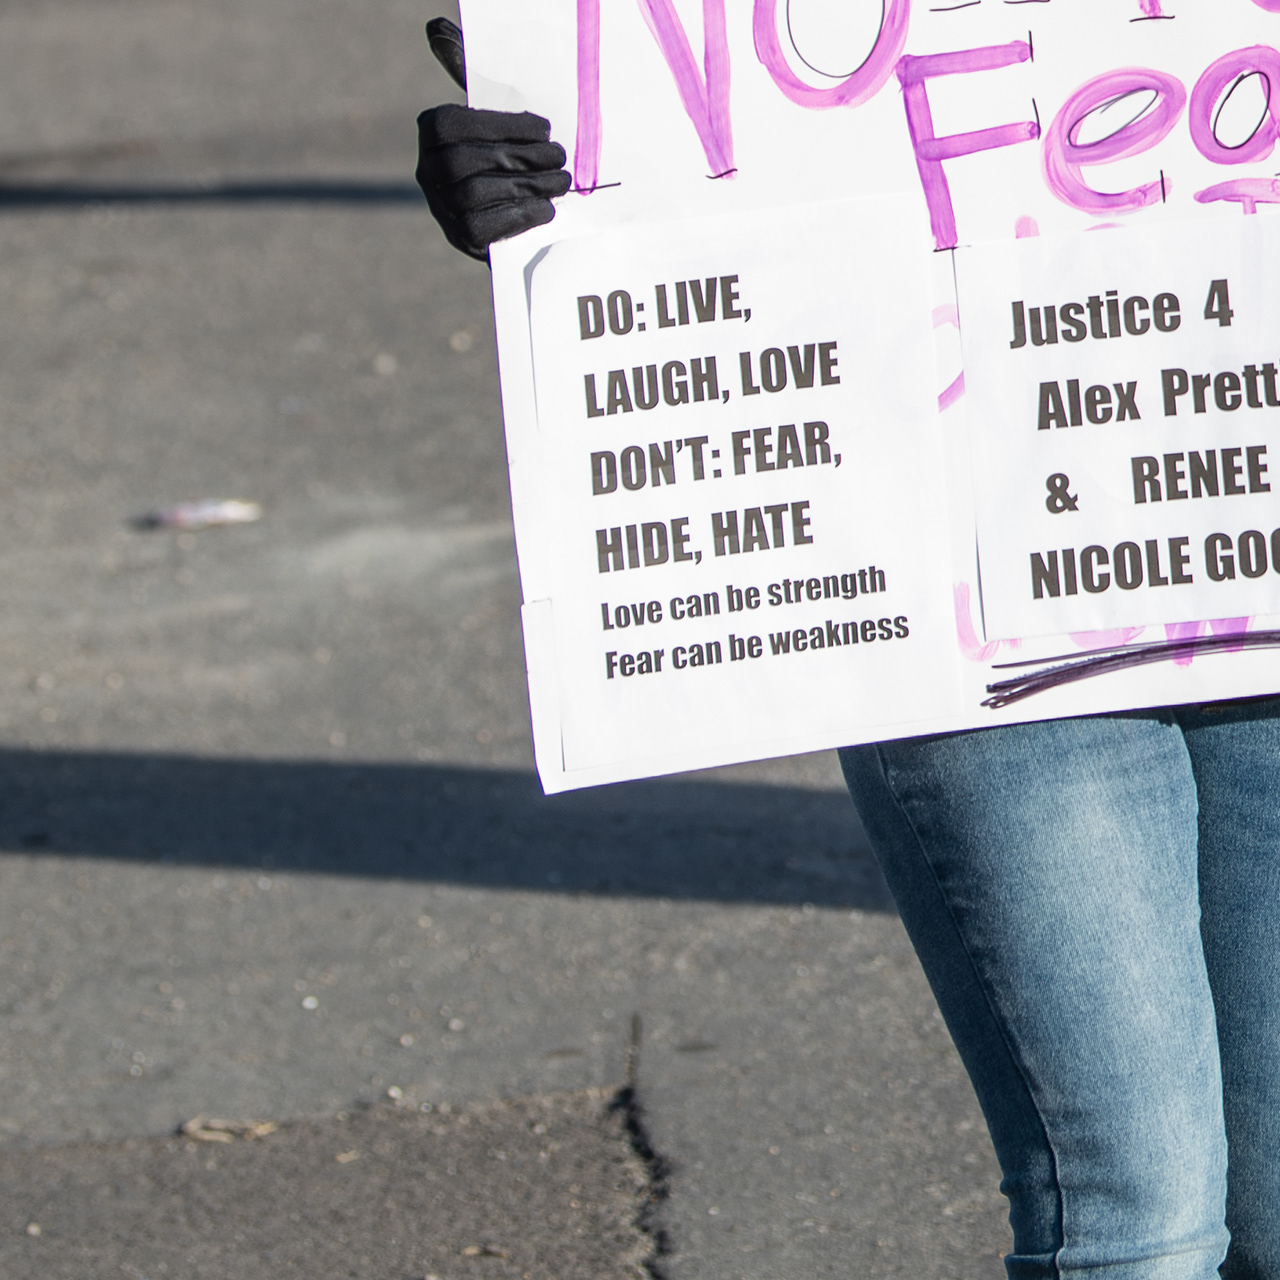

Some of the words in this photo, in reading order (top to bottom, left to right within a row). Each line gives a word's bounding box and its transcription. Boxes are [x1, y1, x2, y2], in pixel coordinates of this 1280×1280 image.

[578, 290, 645, 339] DO:
[656, 275, 751, 328] LIVE,
[1010, 291, 1180, 348] Justice
[1205, 279, 1233, 326] 4
[585, 356, 729, 417] LAUGH,
[740, 341, 840, 395] LOVE
[1038, 379, 1140, 430] Alex
[732, 422, 841, 474] FEAR,
[1047, 473, 1078, 513] &
[1132, 445, 1270, 503] RENEE
[596, 517, 701, 572] HIDE,
[712, 501, 813, 556] HATE
[1031, 537, 1193, 598] NICOLE
[602, 601, 662, 629] Love
[671, 593, 720, 619] can
[727, 585, 760, 611] be
[768, 566, 885, 605] strength
[606, 650, 664, 678] Fear
[673, 642, 721, 669] can
[729, 635, 762, 661] be
[769, 614, 909, 654] weakness
